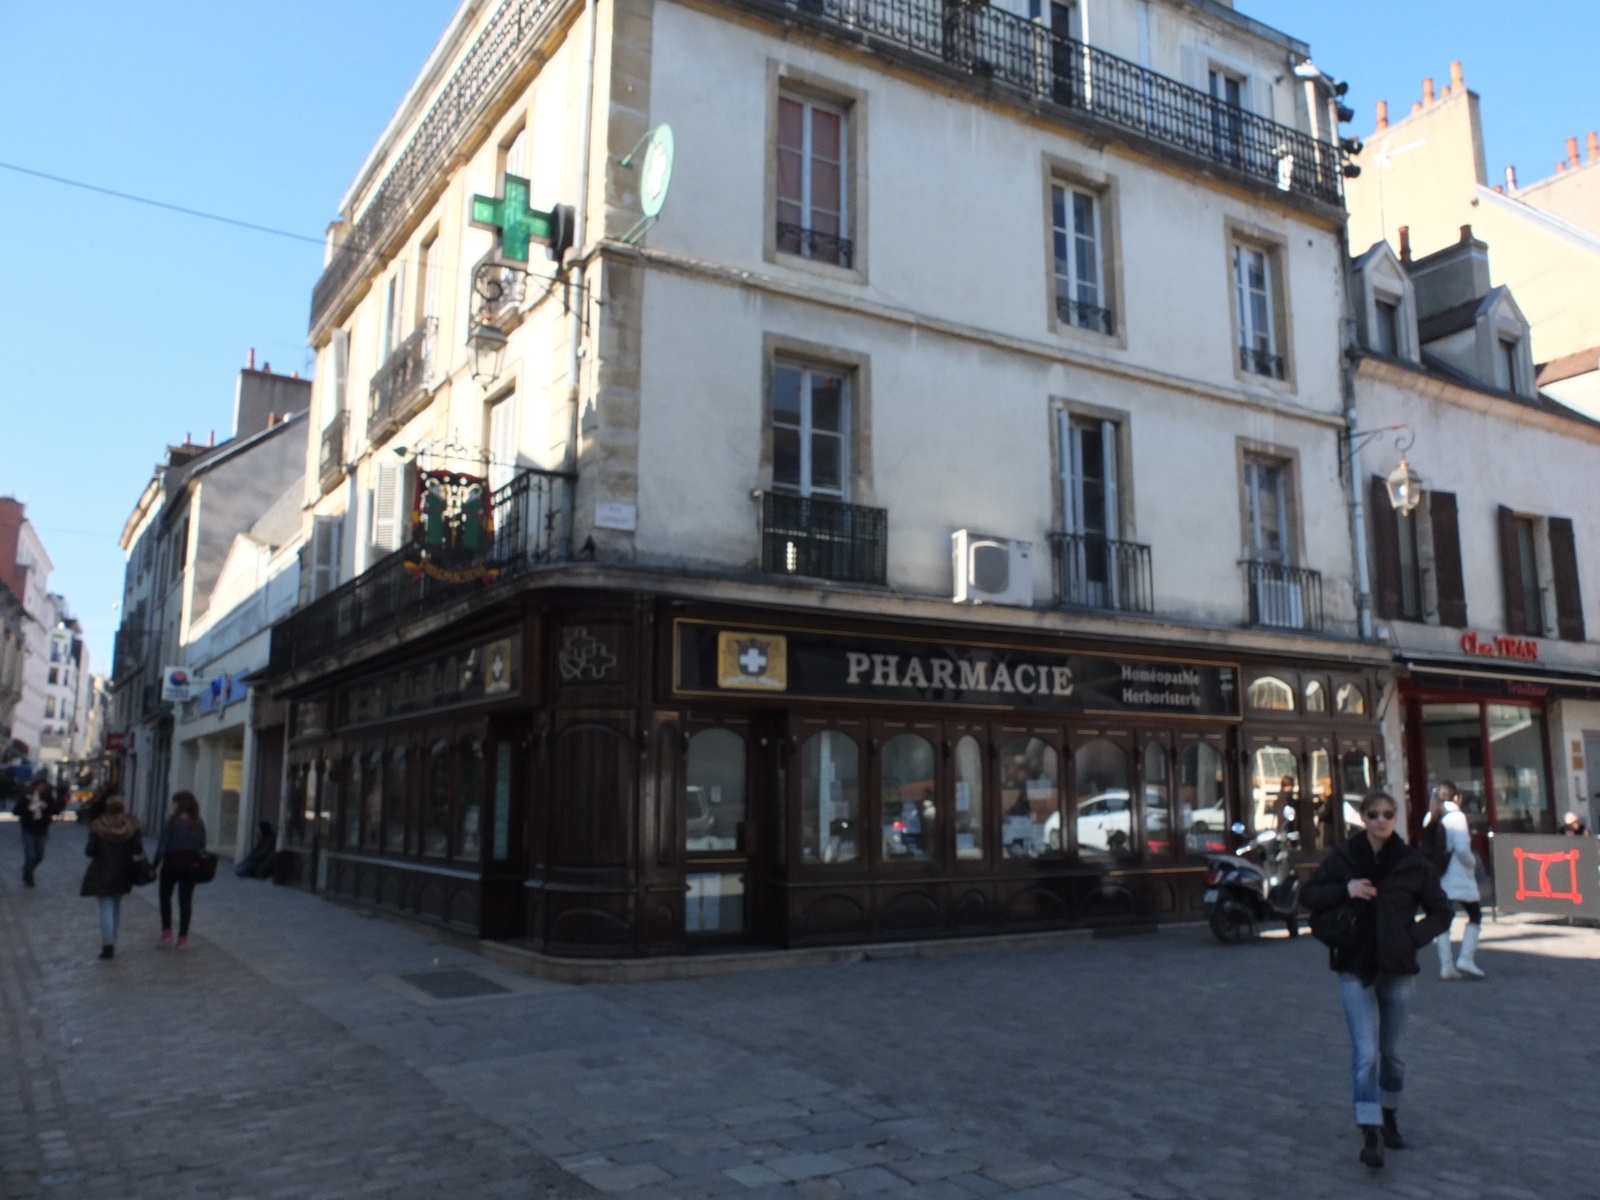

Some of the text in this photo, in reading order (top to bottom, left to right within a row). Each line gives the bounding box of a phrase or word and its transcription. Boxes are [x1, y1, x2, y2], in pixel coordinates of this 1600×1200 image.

[1461, 631, 1538, 660] Chez TRAN
[846, 652, 1074, 696] PHARMACIE
[1121, 664, 1200, 686] Homéopathie
[1122, 687, 1201, 706] Herboristerie
